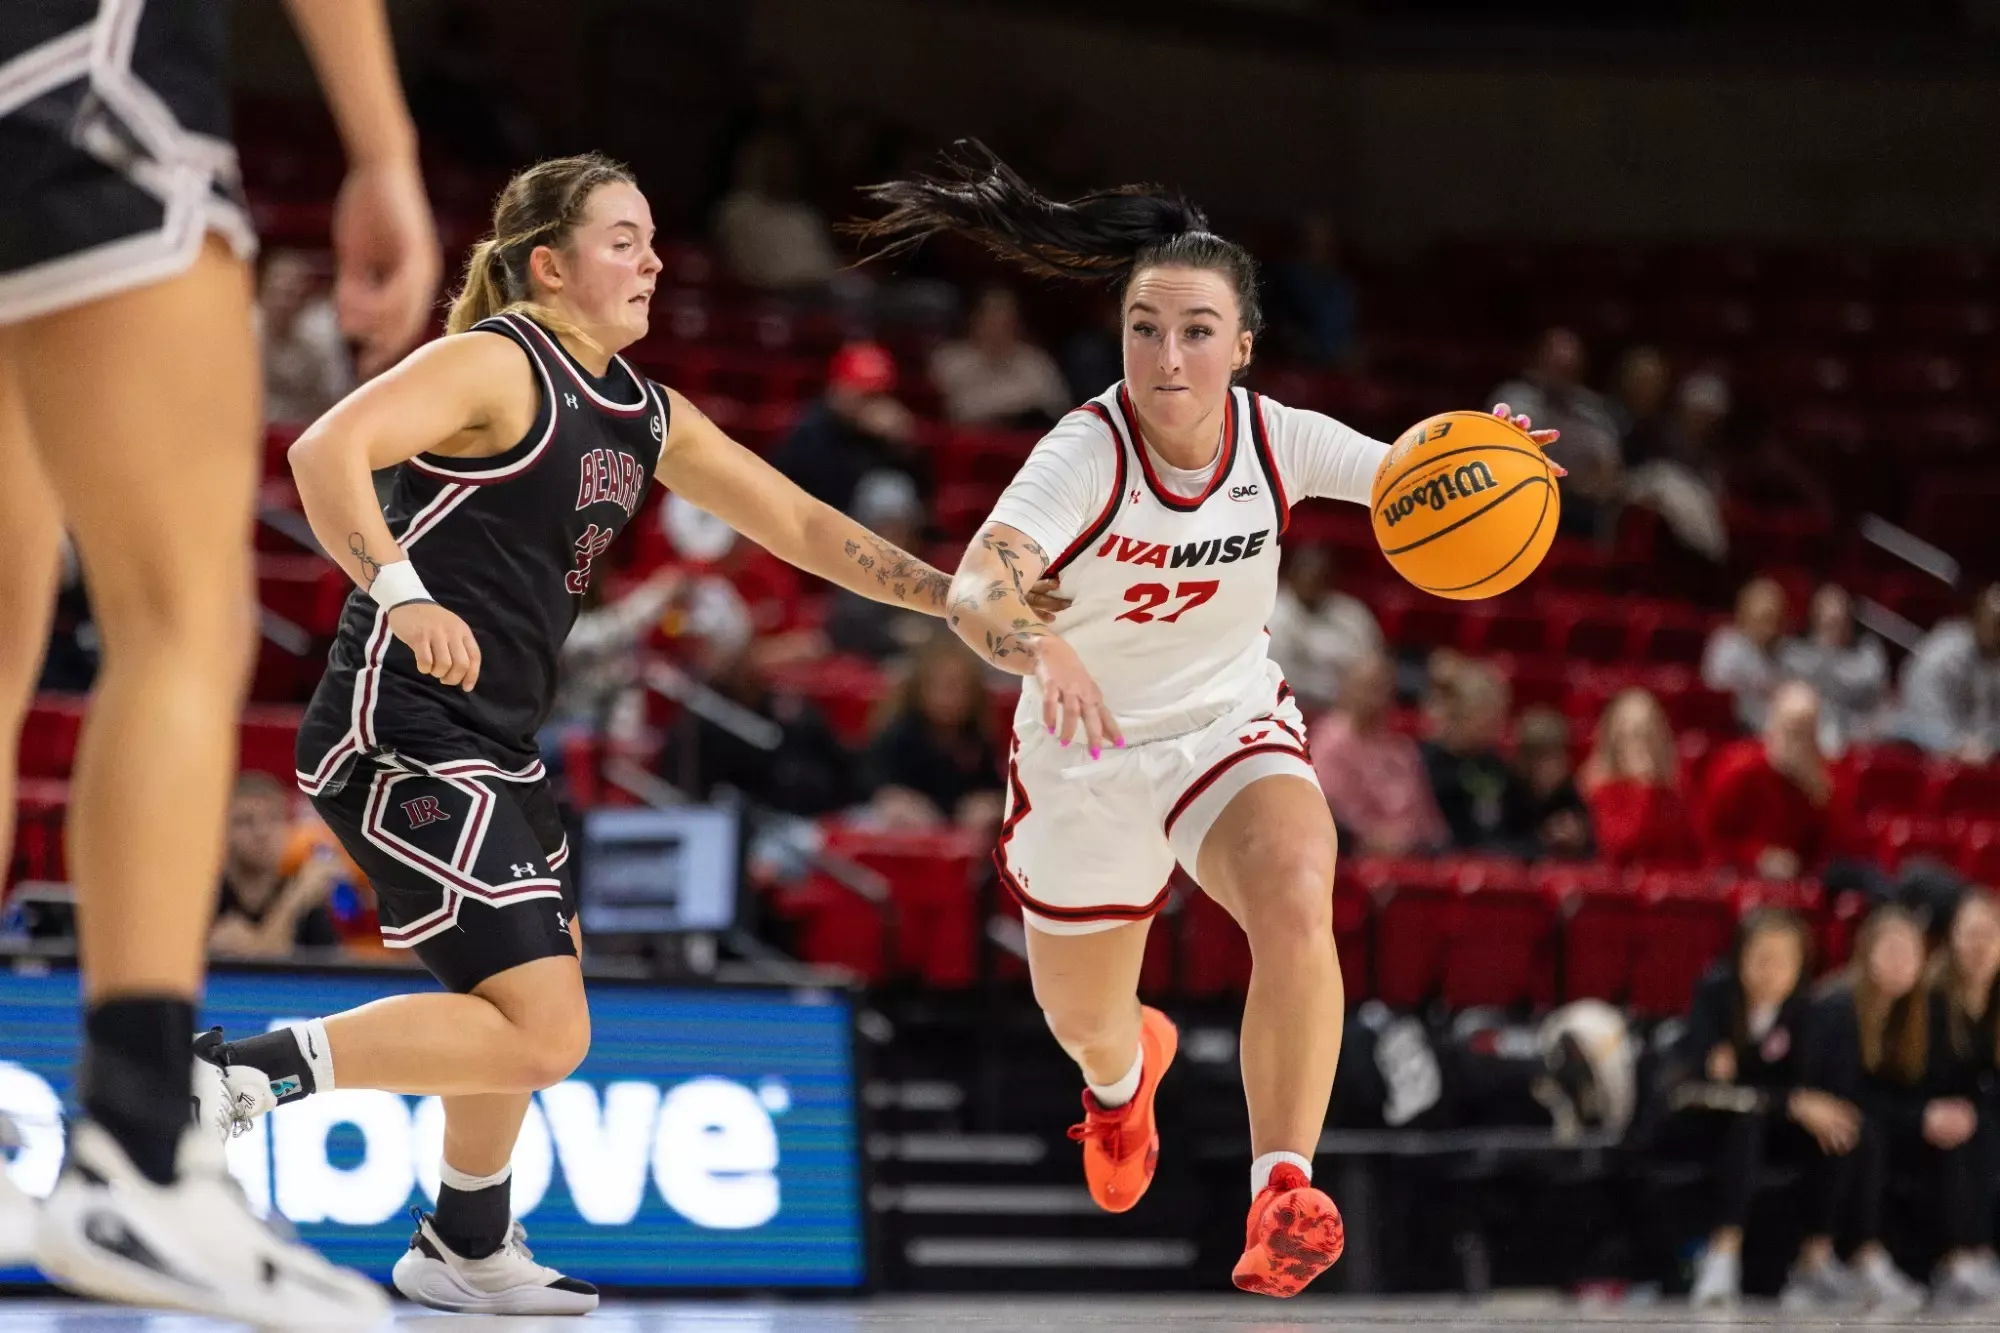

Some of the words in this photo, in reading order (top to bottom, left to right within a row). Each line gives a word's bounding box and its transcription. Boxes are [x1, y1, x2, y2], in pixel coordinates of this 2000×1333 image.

[1231, 484, 1259, 498] SAC
[1382, 460, 1498, 527] Wilson
[1114, 580, 1220, 624] 27
